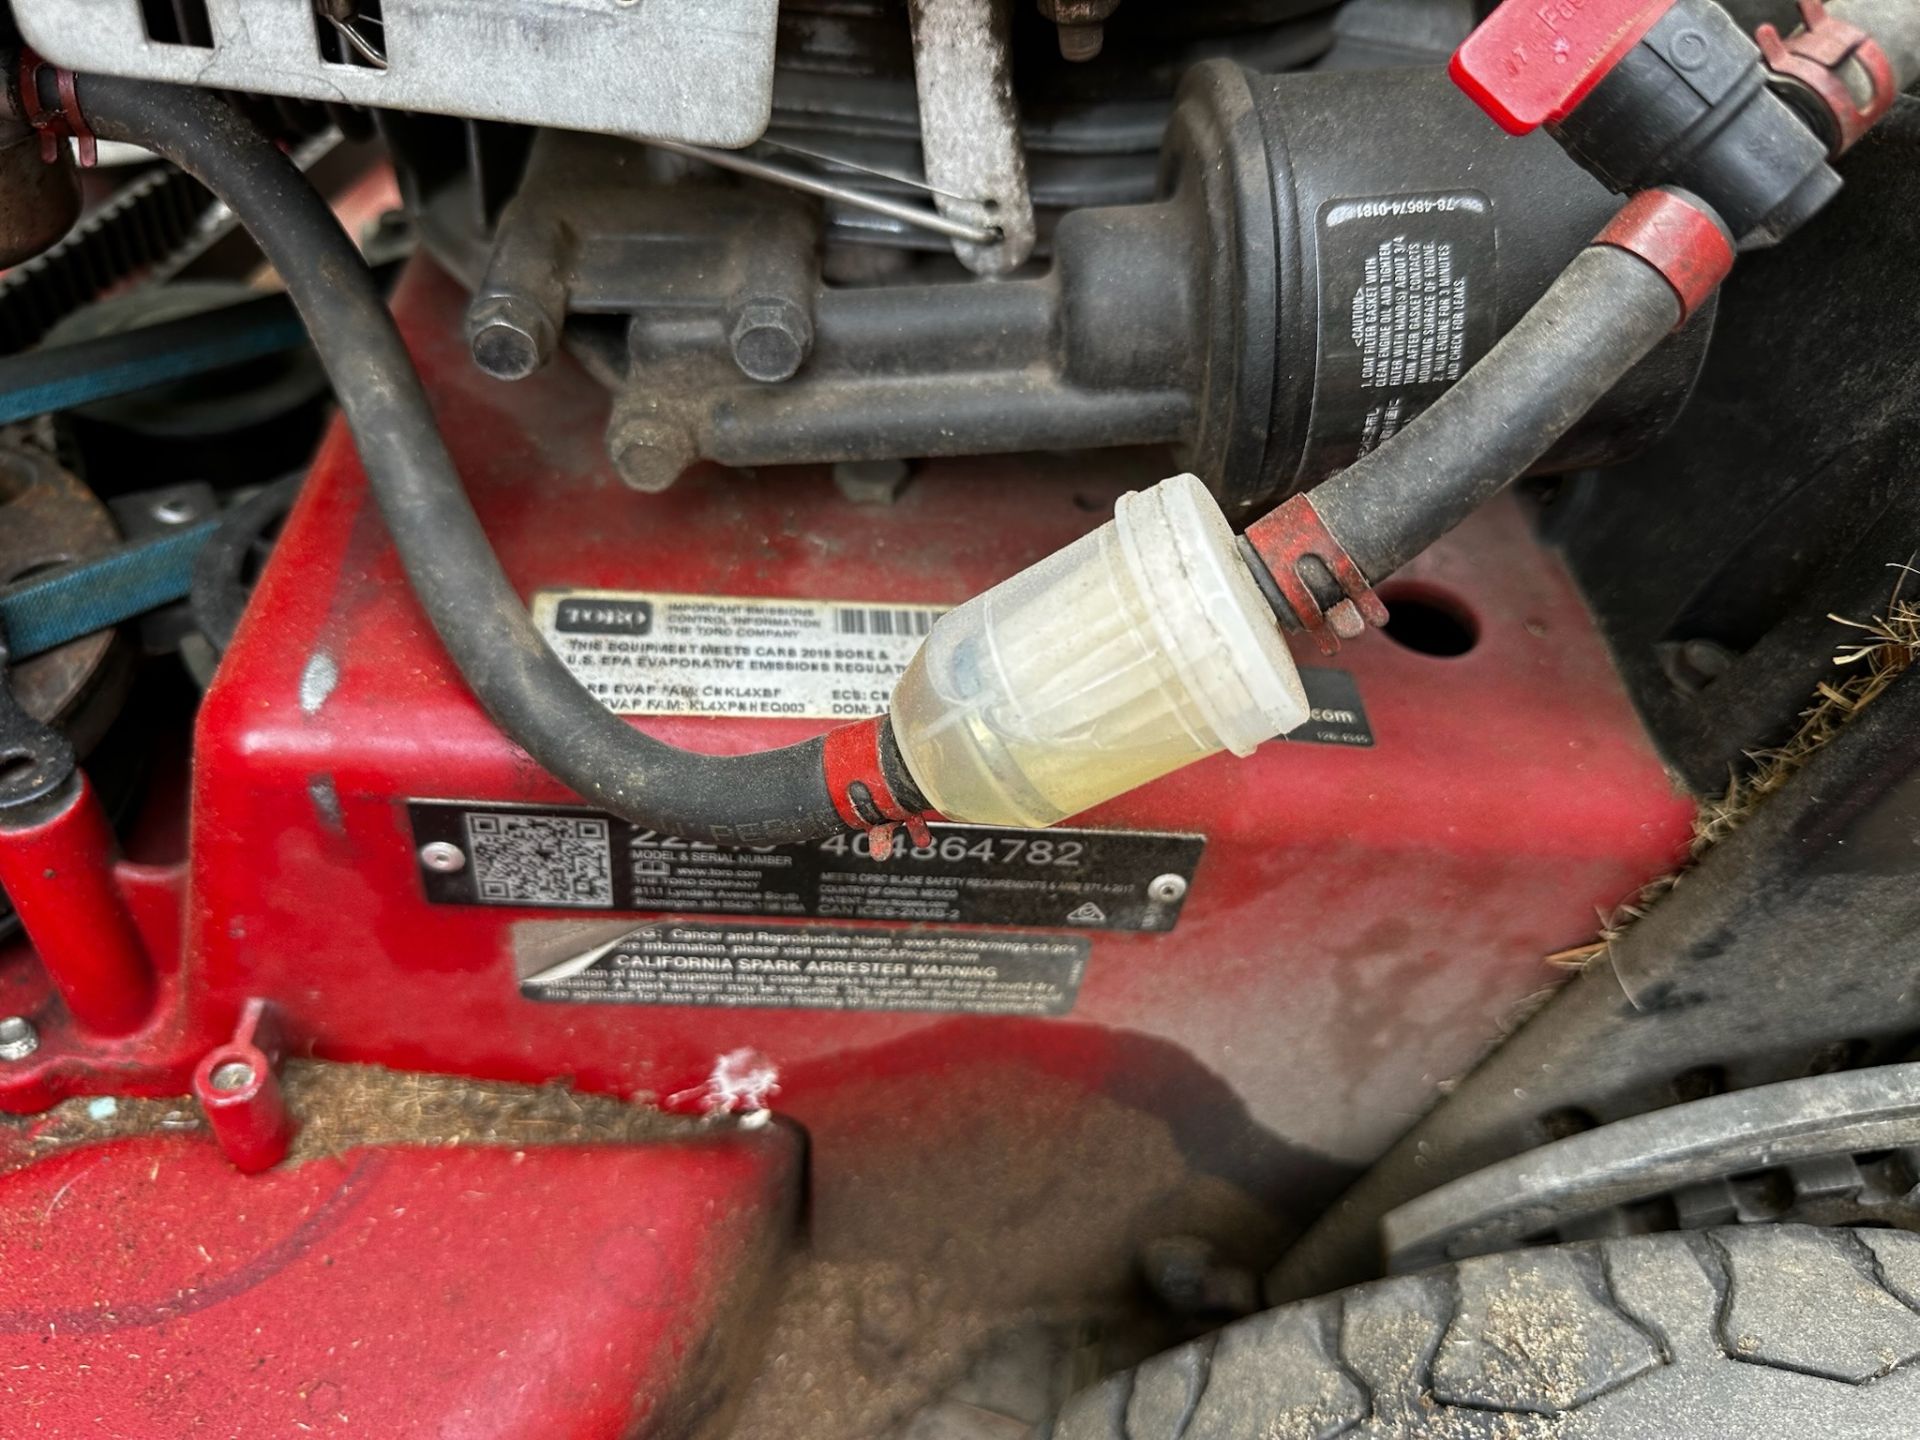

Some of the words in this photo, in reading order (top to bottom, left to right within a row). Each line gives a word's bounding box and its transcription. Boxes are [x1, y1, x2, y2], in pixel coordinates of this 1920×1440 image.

[1393, 235, 1406, 254] 3/4
[1365, 257, 1378, 285] WITH
[1379, 240, 1393, 284] TIGHTEN
[1394, 257, 1407, 288] ABOUT
[1408, 243, 1421, 291] CONTACTS
[1438, 244, 1451, 287] MINUTES
[1381, 285, 1392, 306] AND
[1424, 280, 1436, 293] OF
[1453, 276, 1466, 310] LEAKS.
[1352, 287, 1365, 347] <CAUTION>
[1365, 287, 1378, 323] GASKET
[1380, 308, 1392, 324] OIL
[1394, 291, 1407, 331] HAND(S)
[1409, 295, 1421, 330] GASKET
[1423, 295, 1436, 336] SURFACE
[1438, 298, 1450, 317] FOR
[1452, 312, 1464, 331] FOR
[1364, 325, 1377, 355] FILTER
[1378, 325, 1392, 358] ENGINE
[1392, 333, 1405, 358] WITH
[1406, 332, 1420, 360] AFTER
[1436, 318, 1450, 352] ENGINE
[1449, 333, 1463, 361] CHECK
[1362, 357, 1376, 379] COAT
[1389, 359, 1403, 386] FILTER
[1418, 337, 1434, 384] MOUNTING
[1434, 353, 1447, 372] RUN
[1447, 361, 1459, 381] AND
[1375, 360, 1390, 388] CLEAN
[1403, 361, 1418, 385] TURN
[667, 613, 727, 626] CONTROL
[732, 616, 822, 629] INFORMATION
[667, 625, 693, 635] THE
[736, 628, 801, 639] COMPANY
[607, 641, 698, 655] EQUIPMENT
[700, 644, 751, 657] MEETS
[601, 655, 633, 668] EPA
[637, 657, 745, 671] EVAPORATIVE
[749, 660, 831, 673] EMISSIONS
[832, 703, 871, 715] DOM:
[632, 849, 677, 862] MODEL
[680, 851, 689, 862] &
[691, 851, 736, 864] SERIAL
[738, 853, 794, 867] NUMBER
[663, 876, 697, 888] TORO
[699, 878, 760, 890] COMPANY
[676, 866, 763, 879] www.toro.com
[890, 874, 924, 885] BLADE
[925, 876, 965, 887] SAFETY
[817, 903, 853, 915] CAN
[673, 928, 722, 941] Cancer
[727, 931, 754, 942] and
[757, 931, 851, 947] Reproductive
[733, 943, 780, 957] please
[615, 953, 735, 971] CALIFORNIA
[738, 957, 801, 972] SPARK
[803, 959, 907, 976] ARRESTER
[912, 962, 999, 979] WARNING
